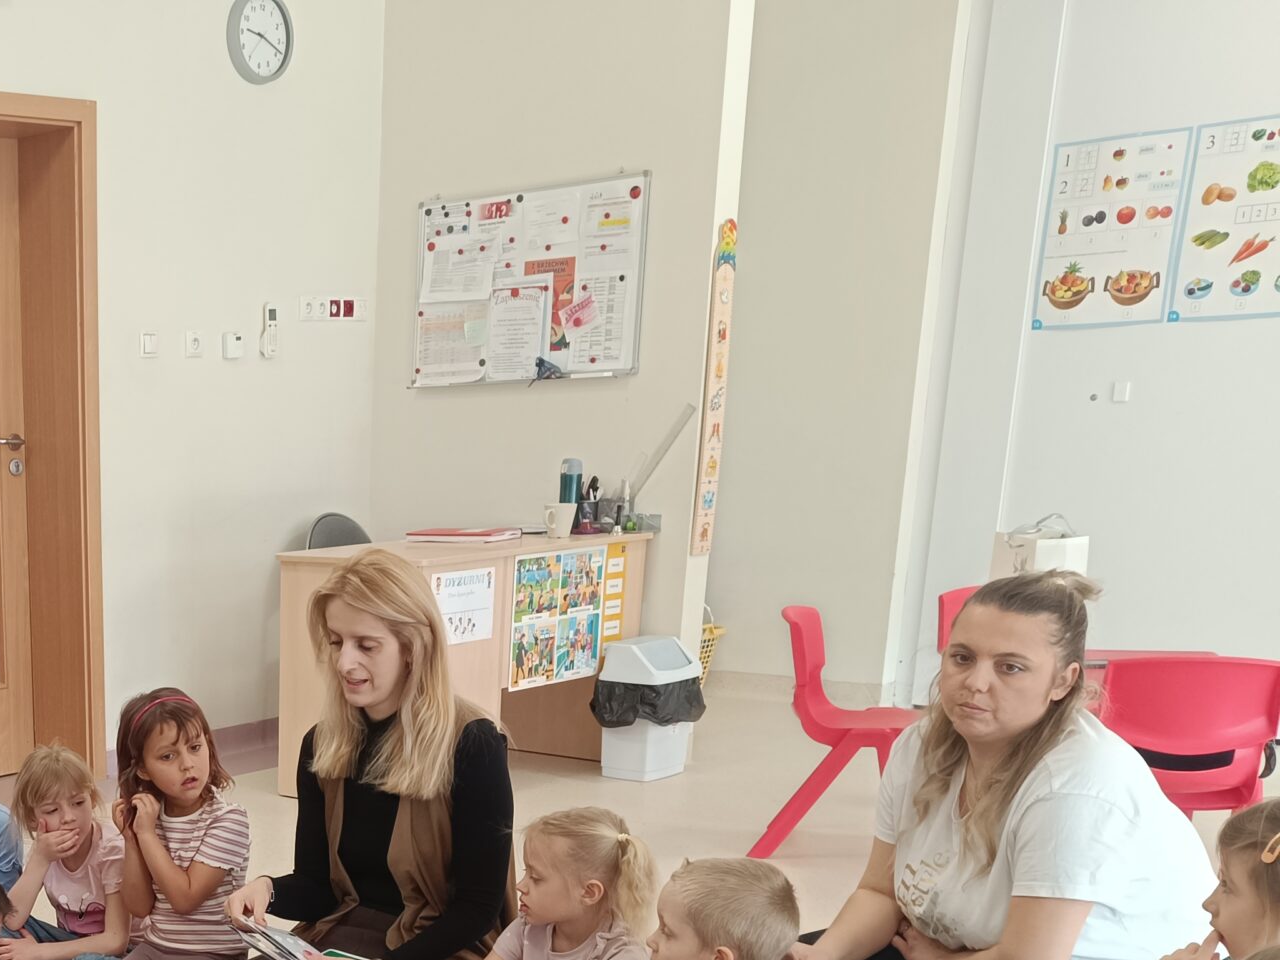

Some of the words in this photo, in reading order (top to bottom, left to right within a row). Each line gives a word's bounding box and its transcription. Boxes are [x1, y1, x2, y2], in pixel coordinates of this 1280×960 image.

[1206, 135, 1216, 149] 3
[1231, 132, 1240, 147] 3
[1065, 153, 1070, 167] 1
[1058, 181, 1068, 194] 2
[1079, 178, 1088, 192] 2
